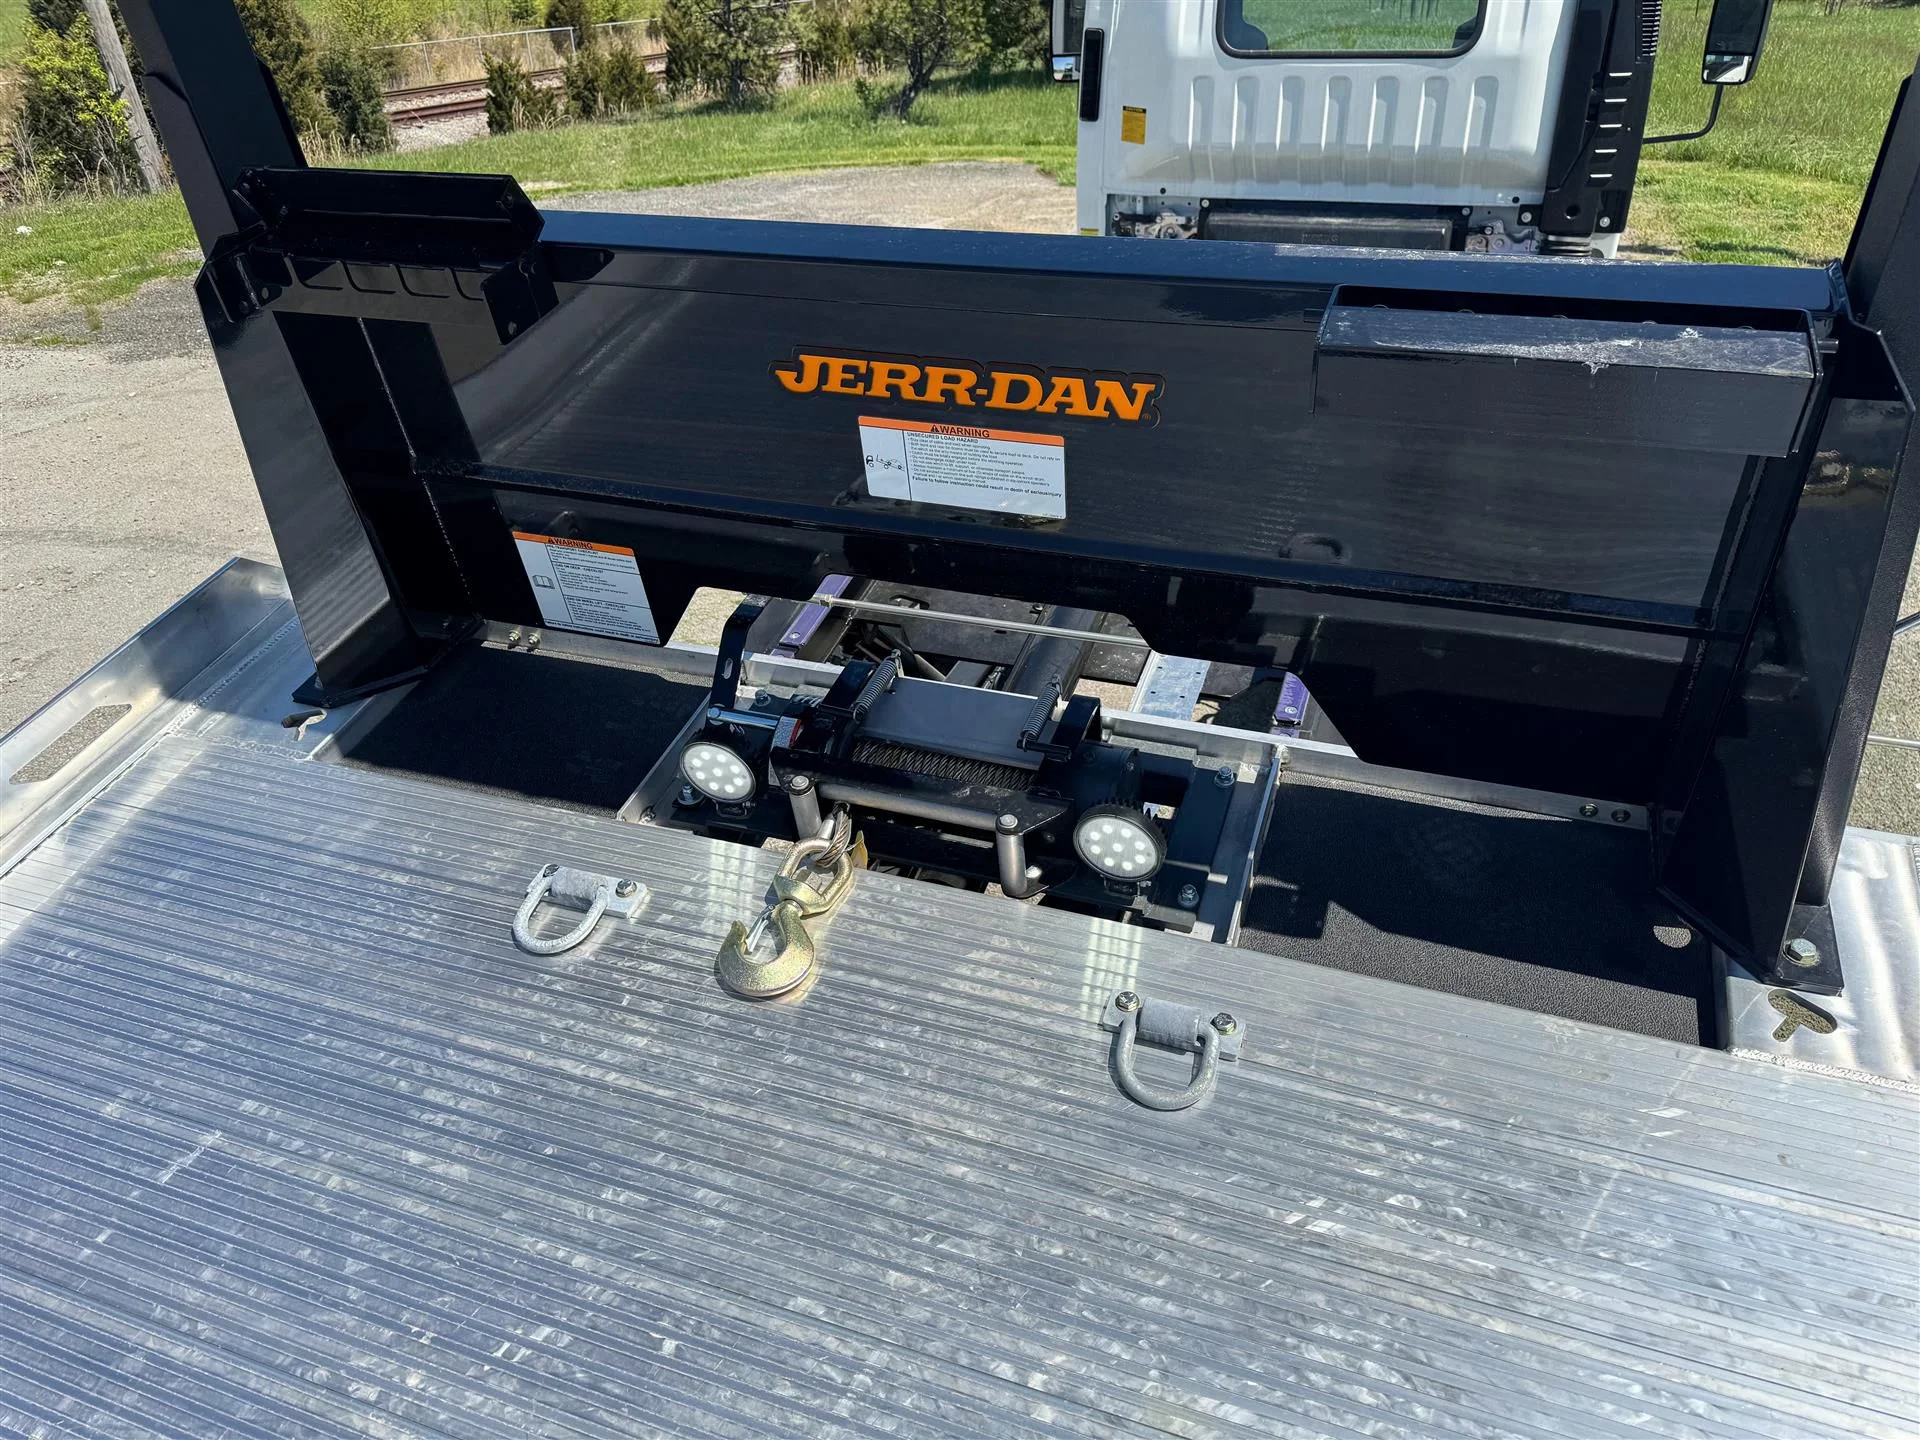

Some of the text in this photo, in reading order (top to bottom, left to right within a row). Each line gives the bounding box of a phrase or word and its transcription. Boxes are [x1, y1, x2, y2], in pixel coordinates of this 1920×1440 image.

[775, 354, 1156, 420] JERR-DAN
[940, 426, 990, 438] WARNING
[554, 538, 593, 549] WARNING
